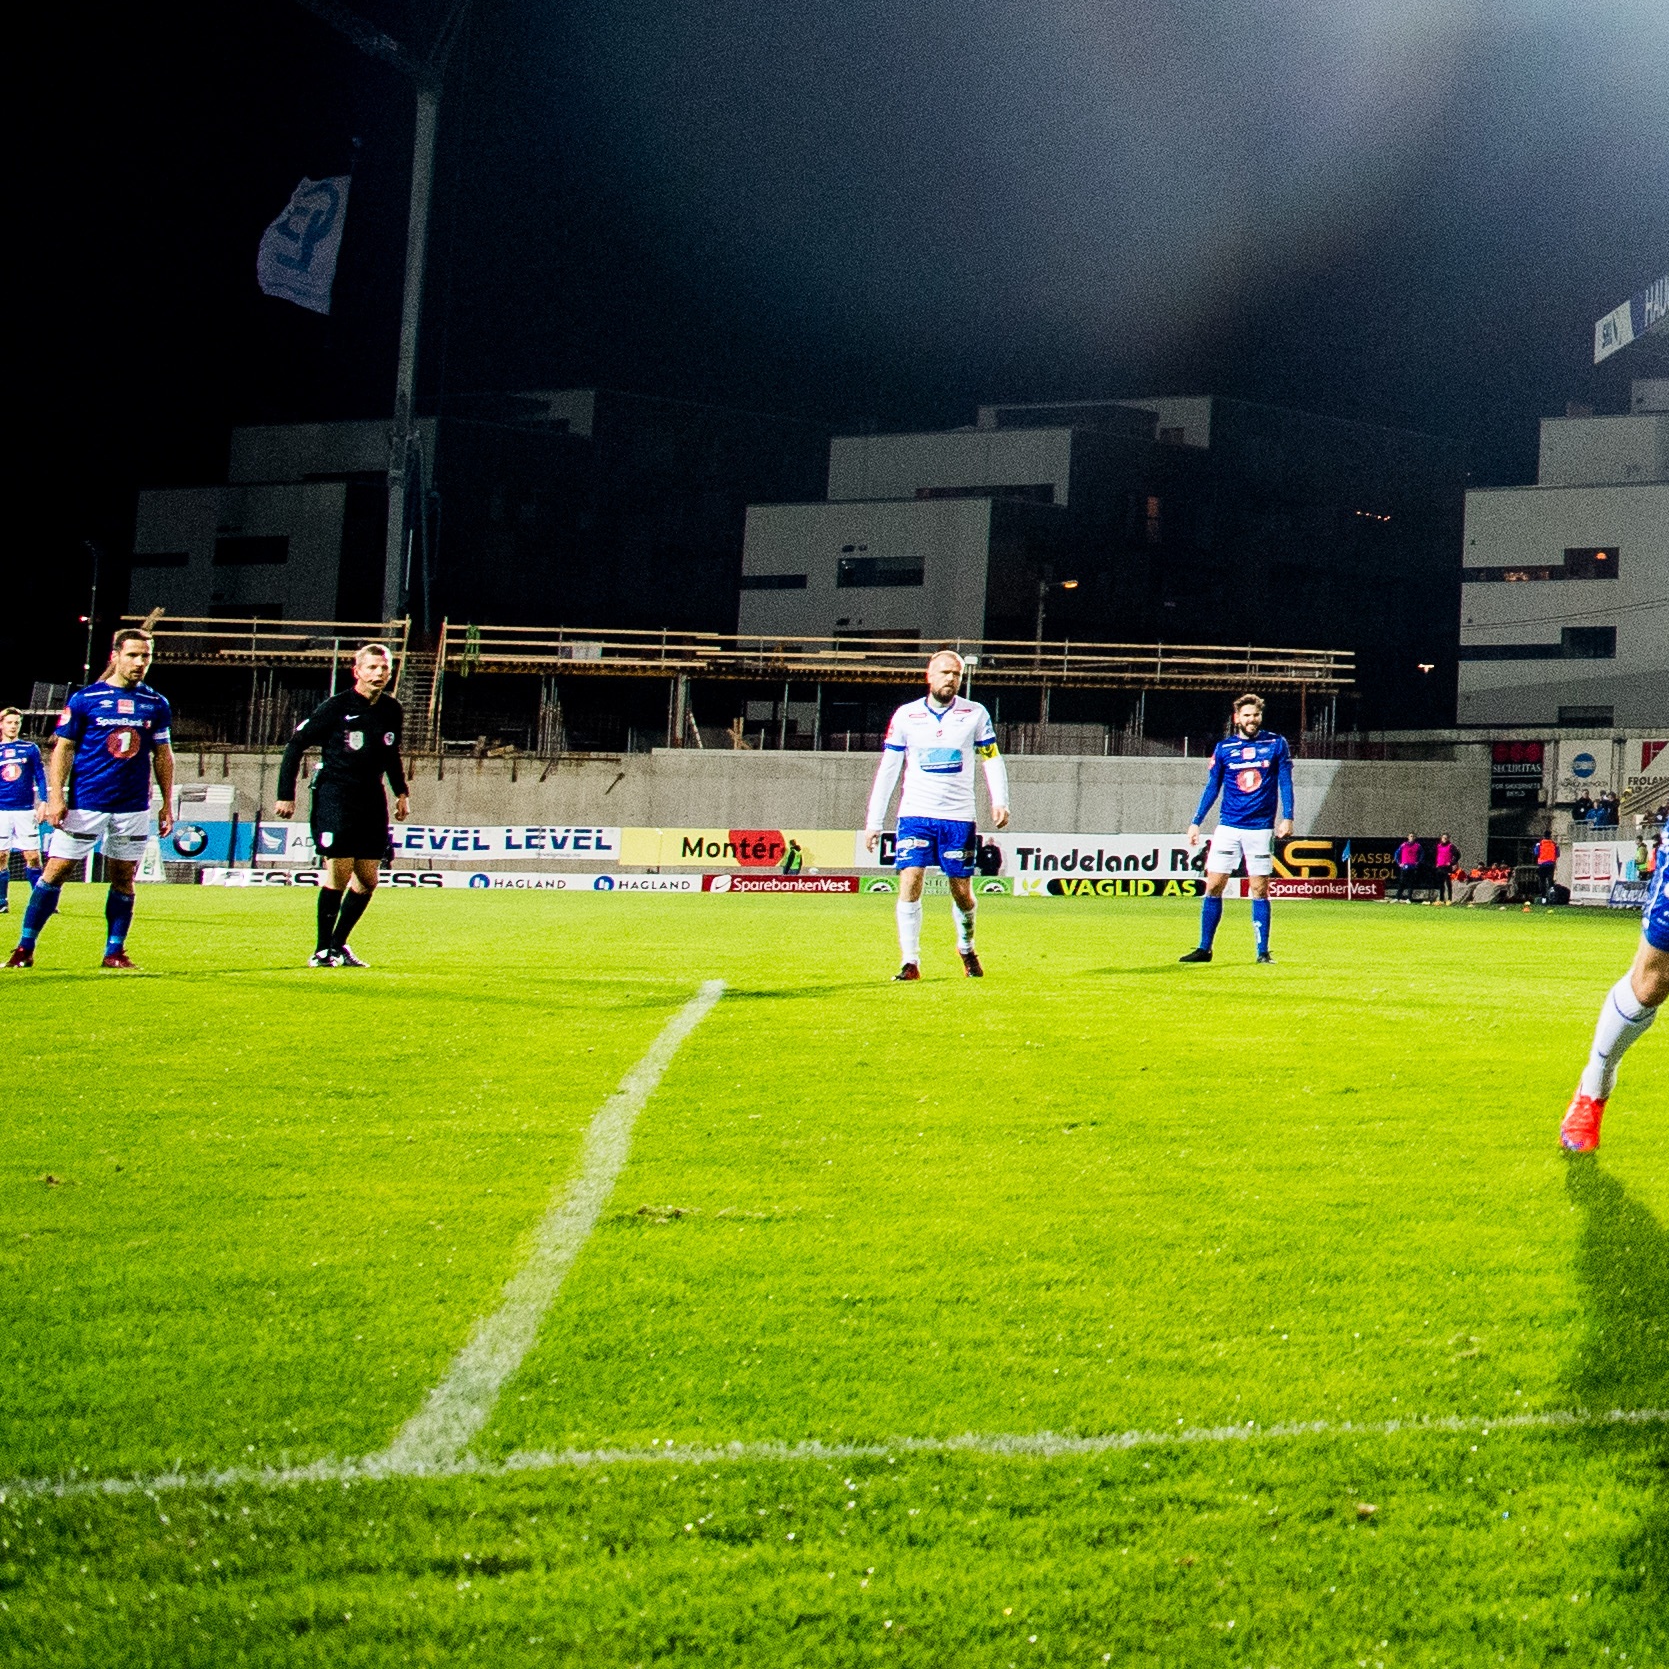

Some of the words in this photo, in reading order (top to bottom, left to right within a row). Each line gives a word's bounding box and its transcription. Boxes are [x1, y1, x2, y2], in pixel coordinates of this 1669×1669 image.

[116, 732, 132, 753] 1
[1493, 763, 1541, 772] SECURITAS
[388, 826, 490, 851] LEVEL
[505, 828, 612, 850] LEVEL
[682, 836, 781, 860] Montér
[1016, 847, 1159, 873] Tindeland
[494, 878, 567, 889] HAGLAND
[618, 880, 691, 890] HAGLAND
[1061, 880, 1156, 897] VAGLID
[1162, 880, 1197, 897] AS
